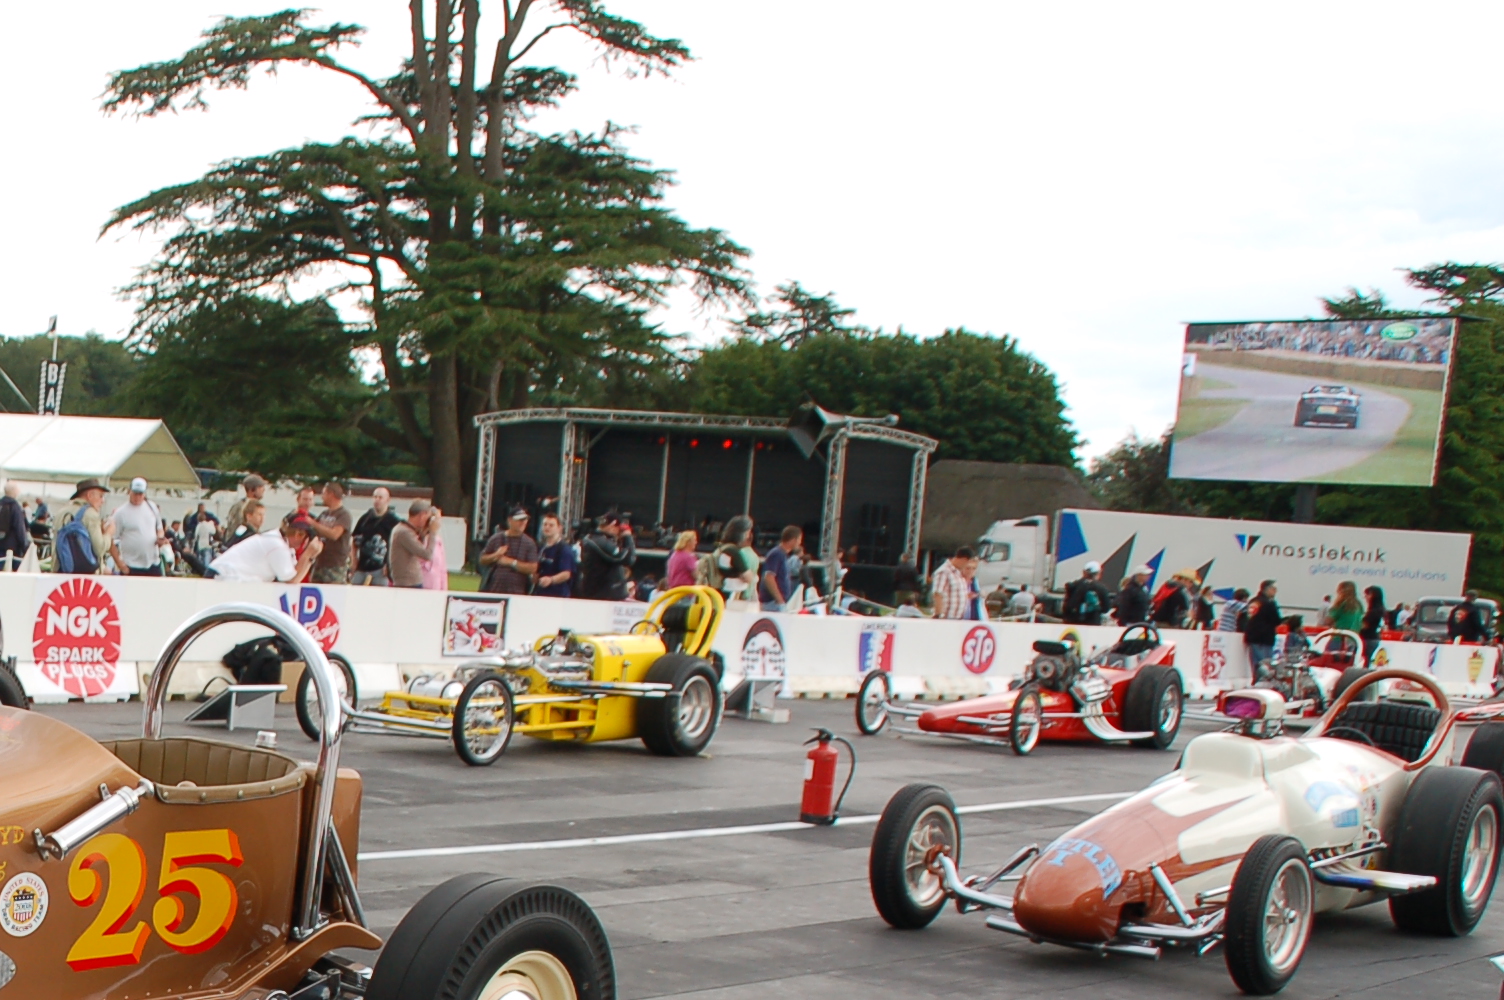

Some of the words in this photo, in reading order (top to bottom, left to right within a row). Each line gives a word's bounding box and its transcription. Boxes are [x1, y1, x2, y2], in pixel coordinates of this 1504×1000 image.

[45, 362, 59, 415] BA
[1262, 542, 1387, 563] massteknik
[47, 605, 109, 638] NGK
[47, 646, 105, 662] SPARK
[964, 628, 995, 668] STP
[47, 663, 109, 680] PLUGS
[66, 829, 244, 972] 25
